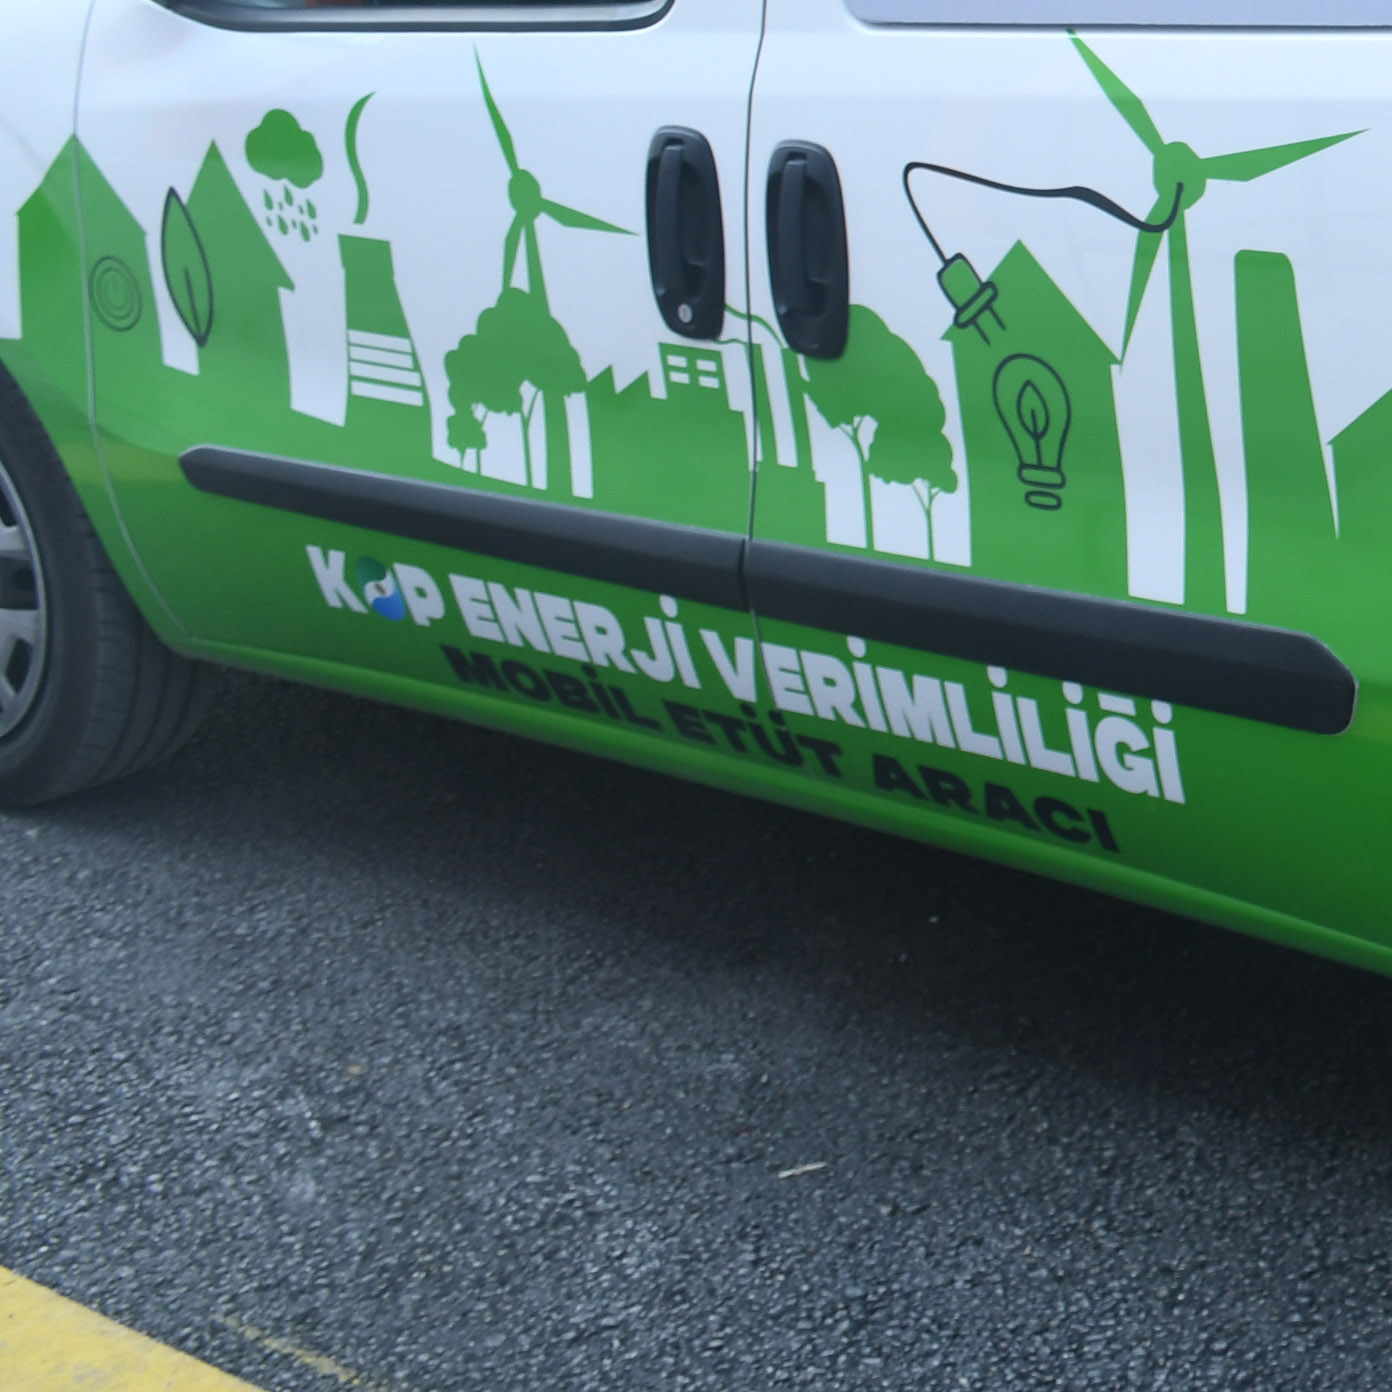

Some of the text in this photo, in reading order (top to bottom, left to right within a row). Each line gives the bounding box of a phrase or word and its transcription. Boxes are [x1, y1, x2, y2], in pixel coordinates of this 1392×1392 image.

[305, 544, 1186, 804] KOP ENERJİ VERİMLİLİĞİ
[441, 644, 1122, 854] MOBİL ETÜT ARACI
